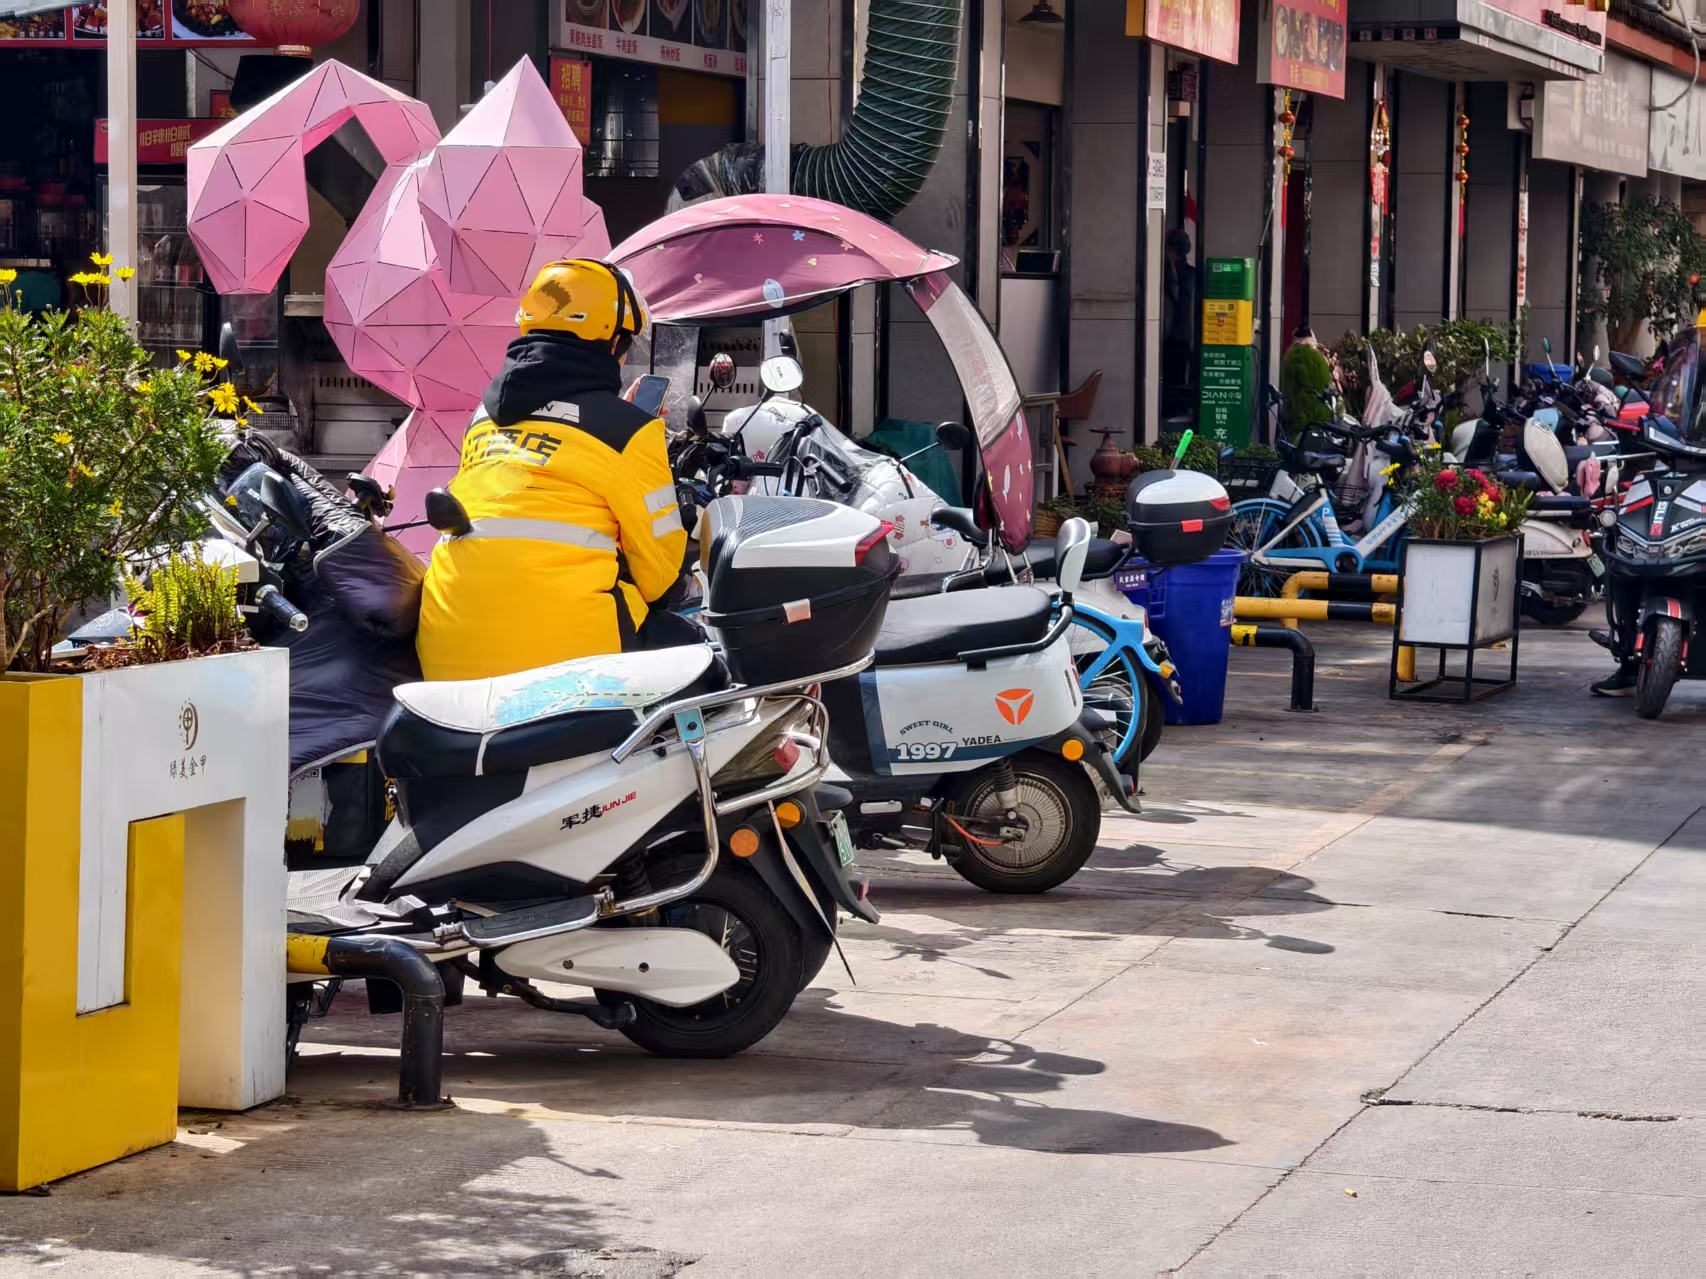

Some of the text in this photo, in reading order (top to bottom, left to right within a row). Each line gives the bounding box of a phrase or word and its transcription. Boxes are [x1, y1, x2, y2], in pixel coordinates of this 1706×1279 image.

[561, 63, 581, 92] 招聘
[899, 720, 954, 736] SWEET GIRL
[962, 734, 1002, 746] YADEA
[895, 741, 958, 761] 1997
[560, 791, 637, 831] 军捷 JUN JIE
